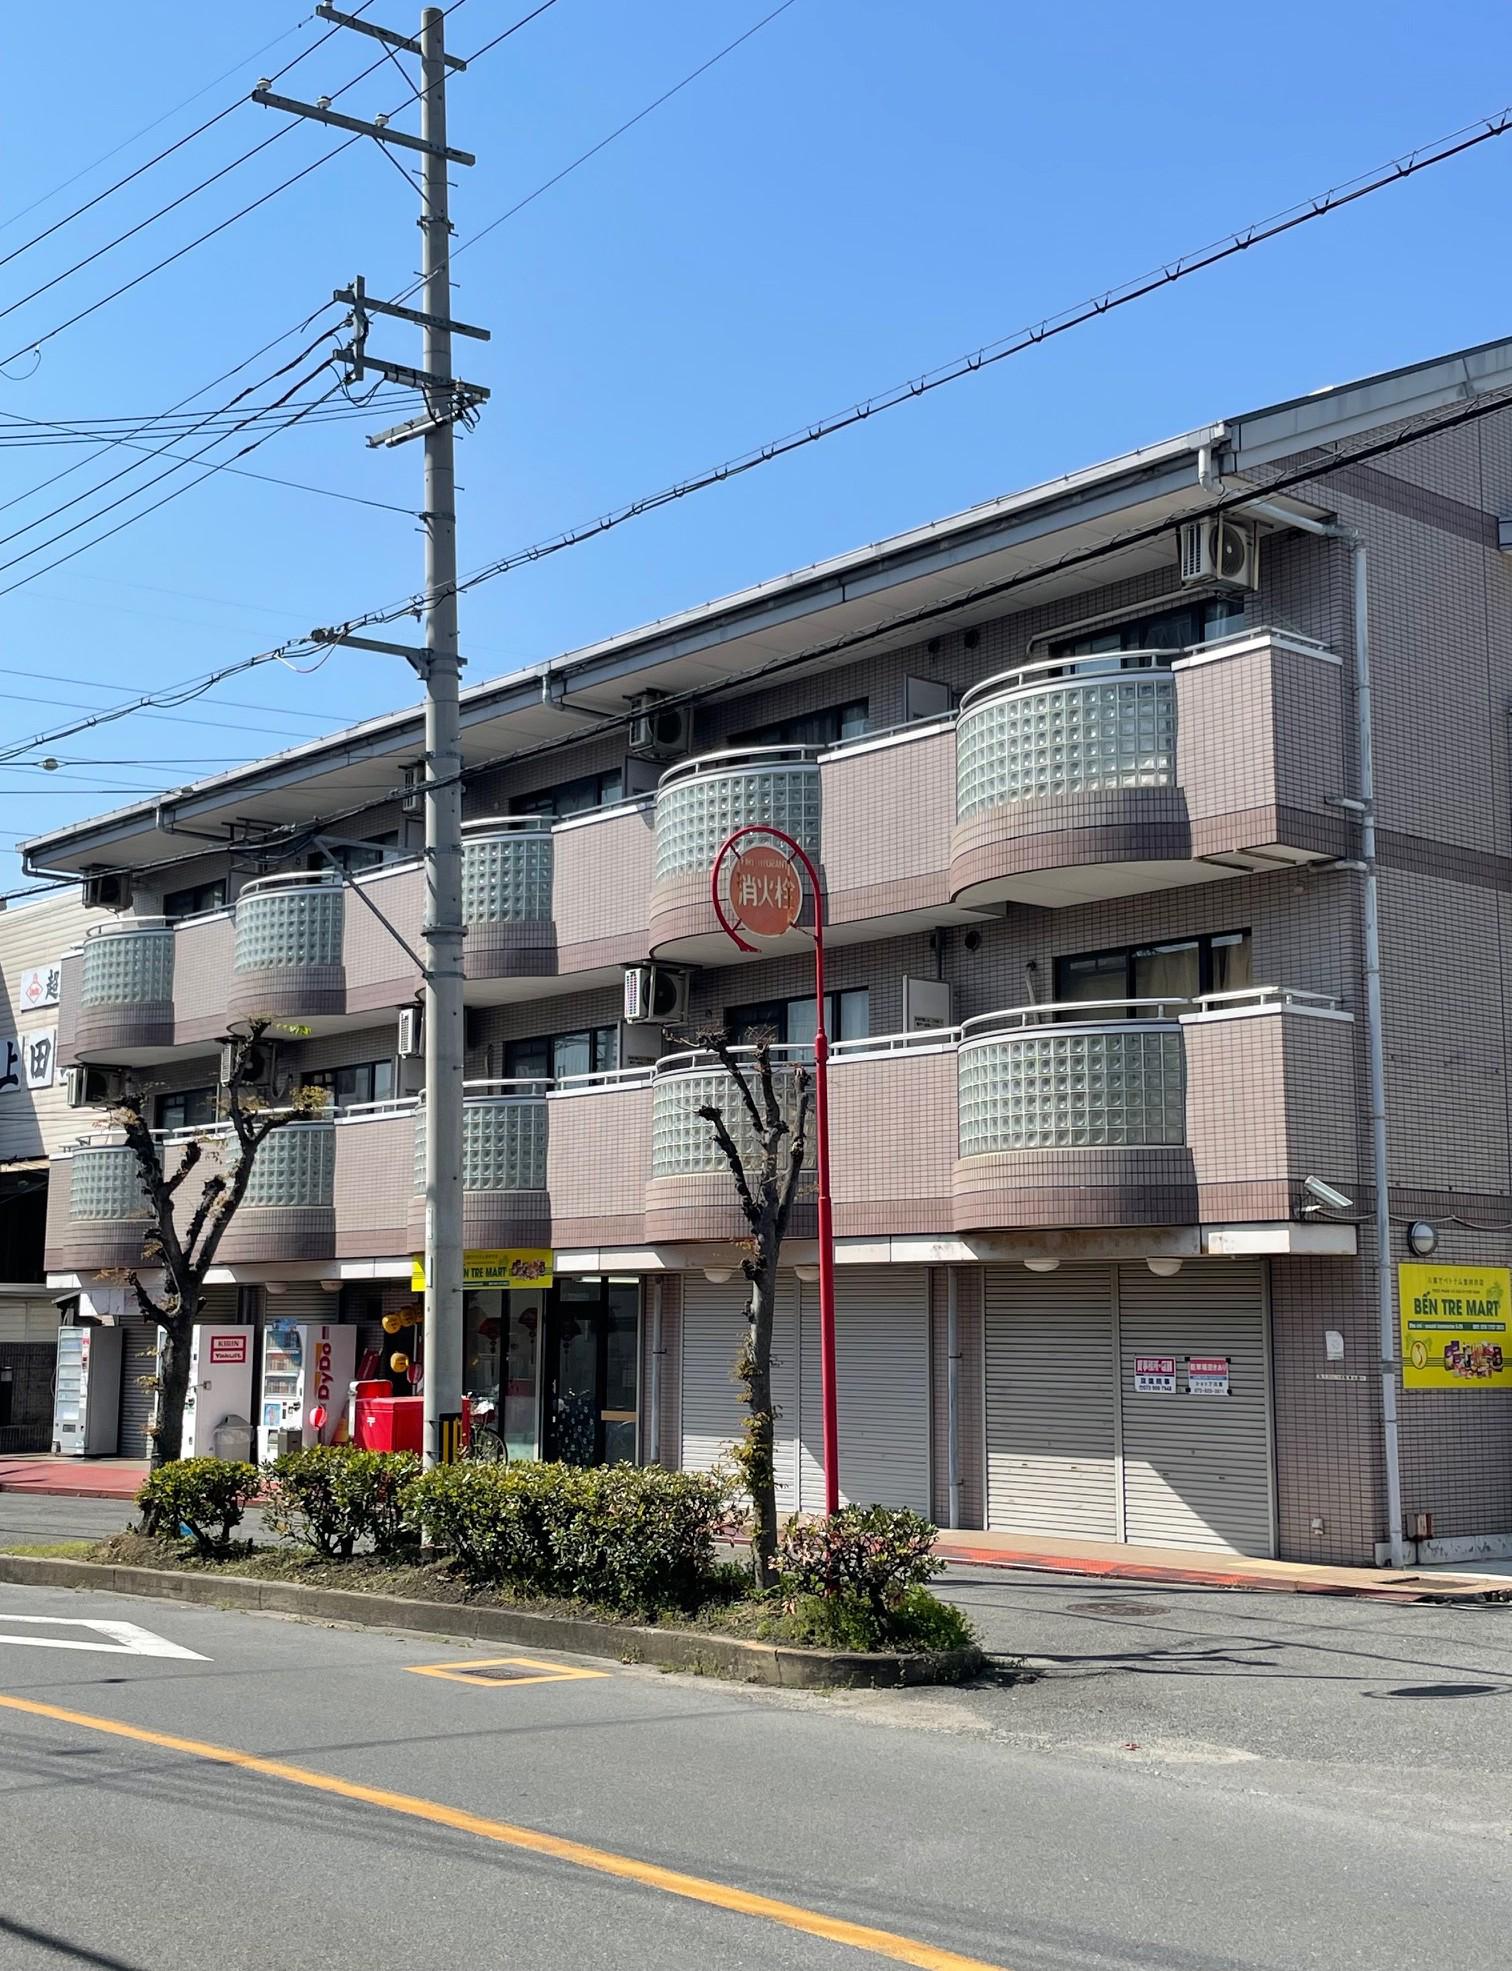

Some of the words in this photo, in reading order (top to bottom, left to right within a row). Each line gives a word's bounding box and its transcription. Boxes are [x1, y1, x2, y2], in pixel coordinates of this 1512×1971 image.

[738, 873, 796, 909] 消火栓
[1441, 1298, 1463, 1317] TRE
[1466, 1299, 1499, 1318] MART
[317, 1342, 334, 1401] DyDo
